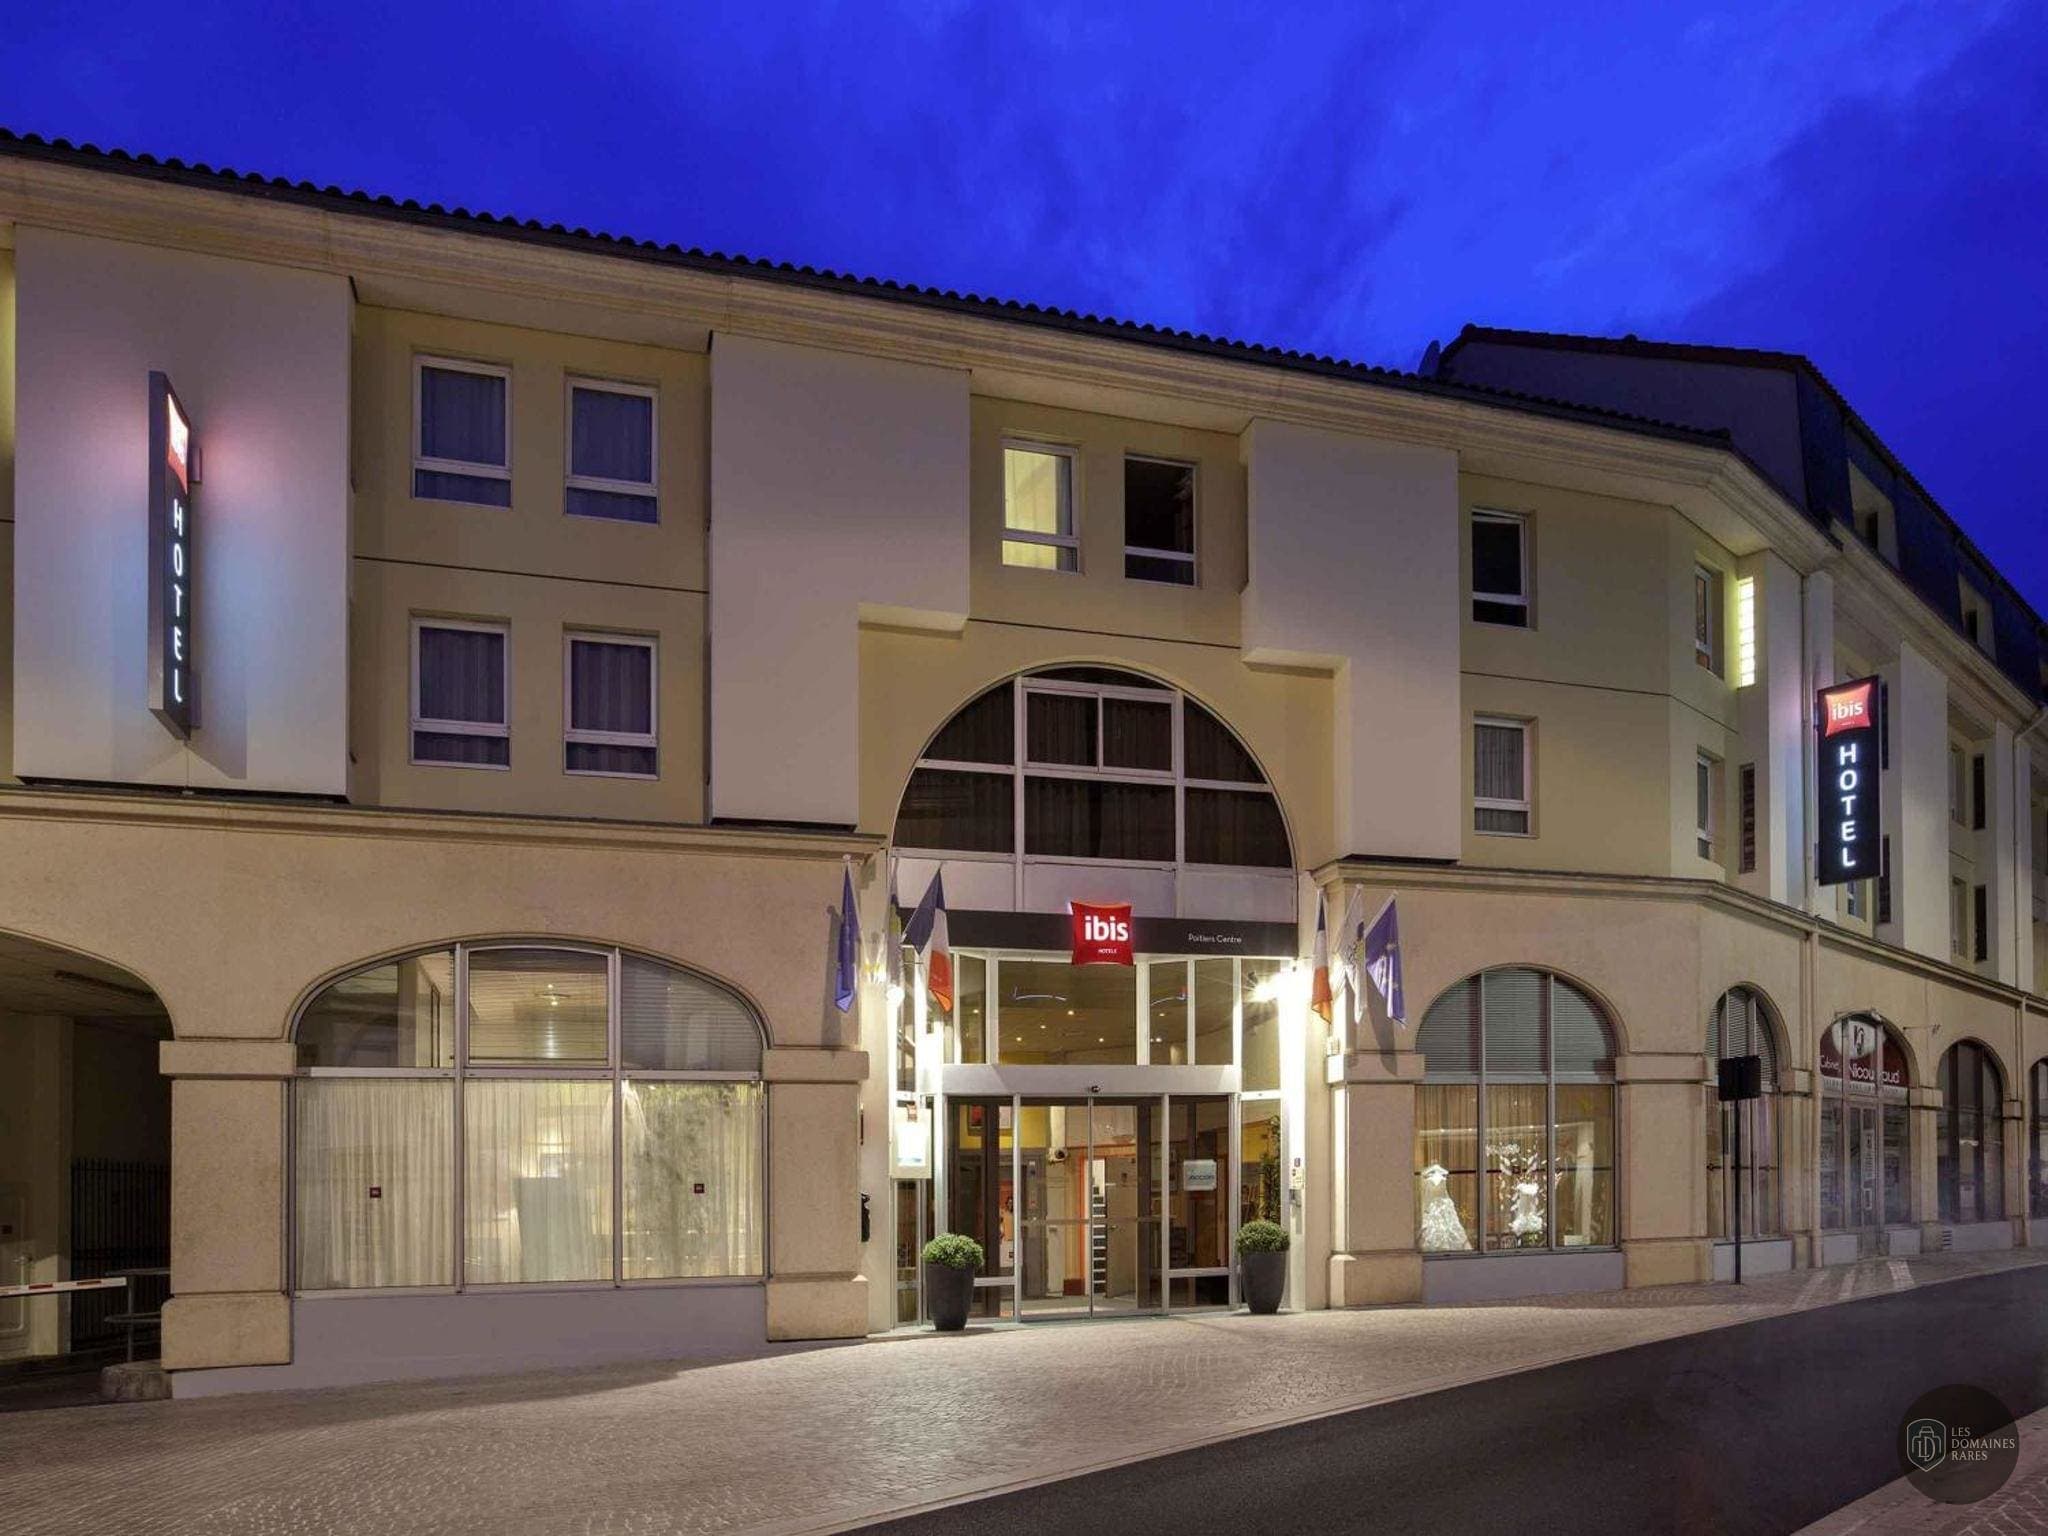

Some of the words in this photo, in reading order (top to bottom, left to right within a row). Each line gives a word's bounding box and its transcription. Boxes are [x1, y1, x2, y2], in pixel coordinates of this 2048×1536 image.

[172, 498, 184, 704] HOTEL
[1830, 700, 1864, 721] ibis
[1839, 743, 1858, 868] HOTEL
[1084, 915, 1129, 942] ibis
[1188, 933, 1215, 942] Poitiers
[1216, 935, 1242, 944] Centre
